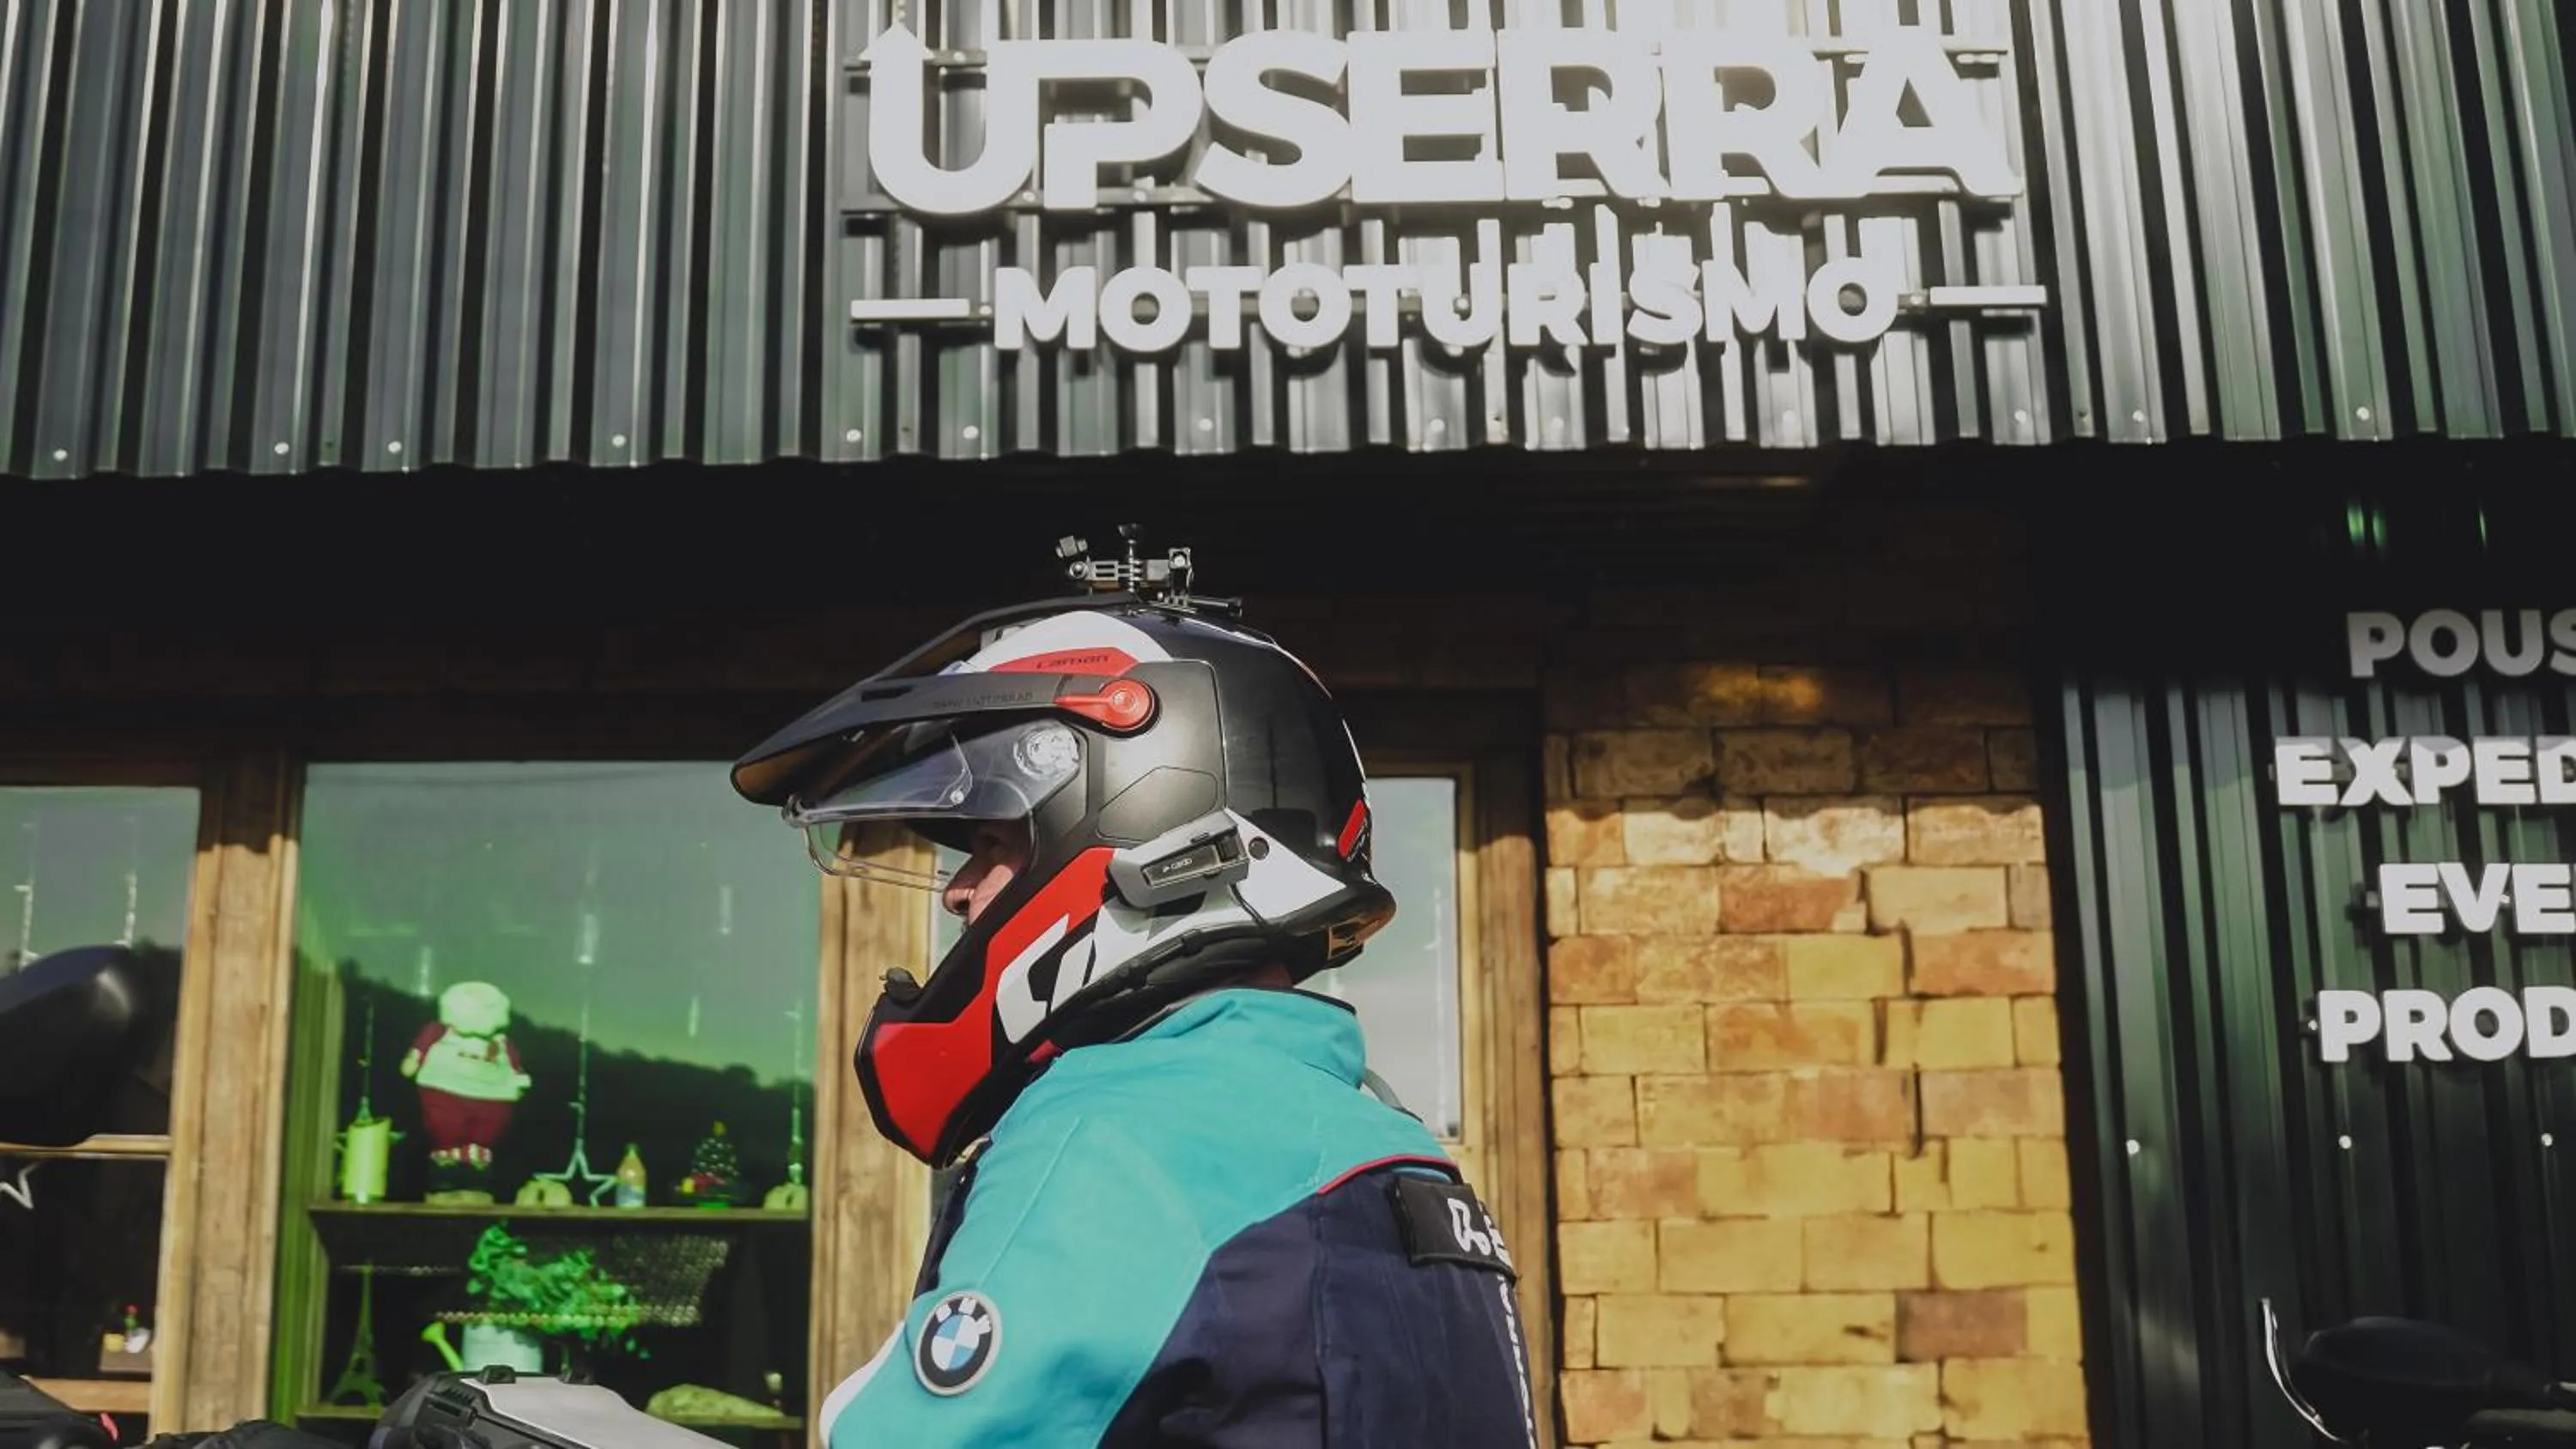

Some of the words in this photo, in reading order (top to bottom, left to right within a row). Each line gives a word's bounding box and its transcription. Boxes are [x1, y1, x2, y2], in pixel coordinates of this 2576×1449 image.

[867, 23, 2022, 215] UPSERRA
[993, 257, 1898, 351] MOTOTURISMO
[2275, 736, 2576, 807] EXPED
[2379, 863, 2576, 935] EVE
[2318, 986, 2576, 1063] PROD
[935, 1296, 992, 1335] BMW
